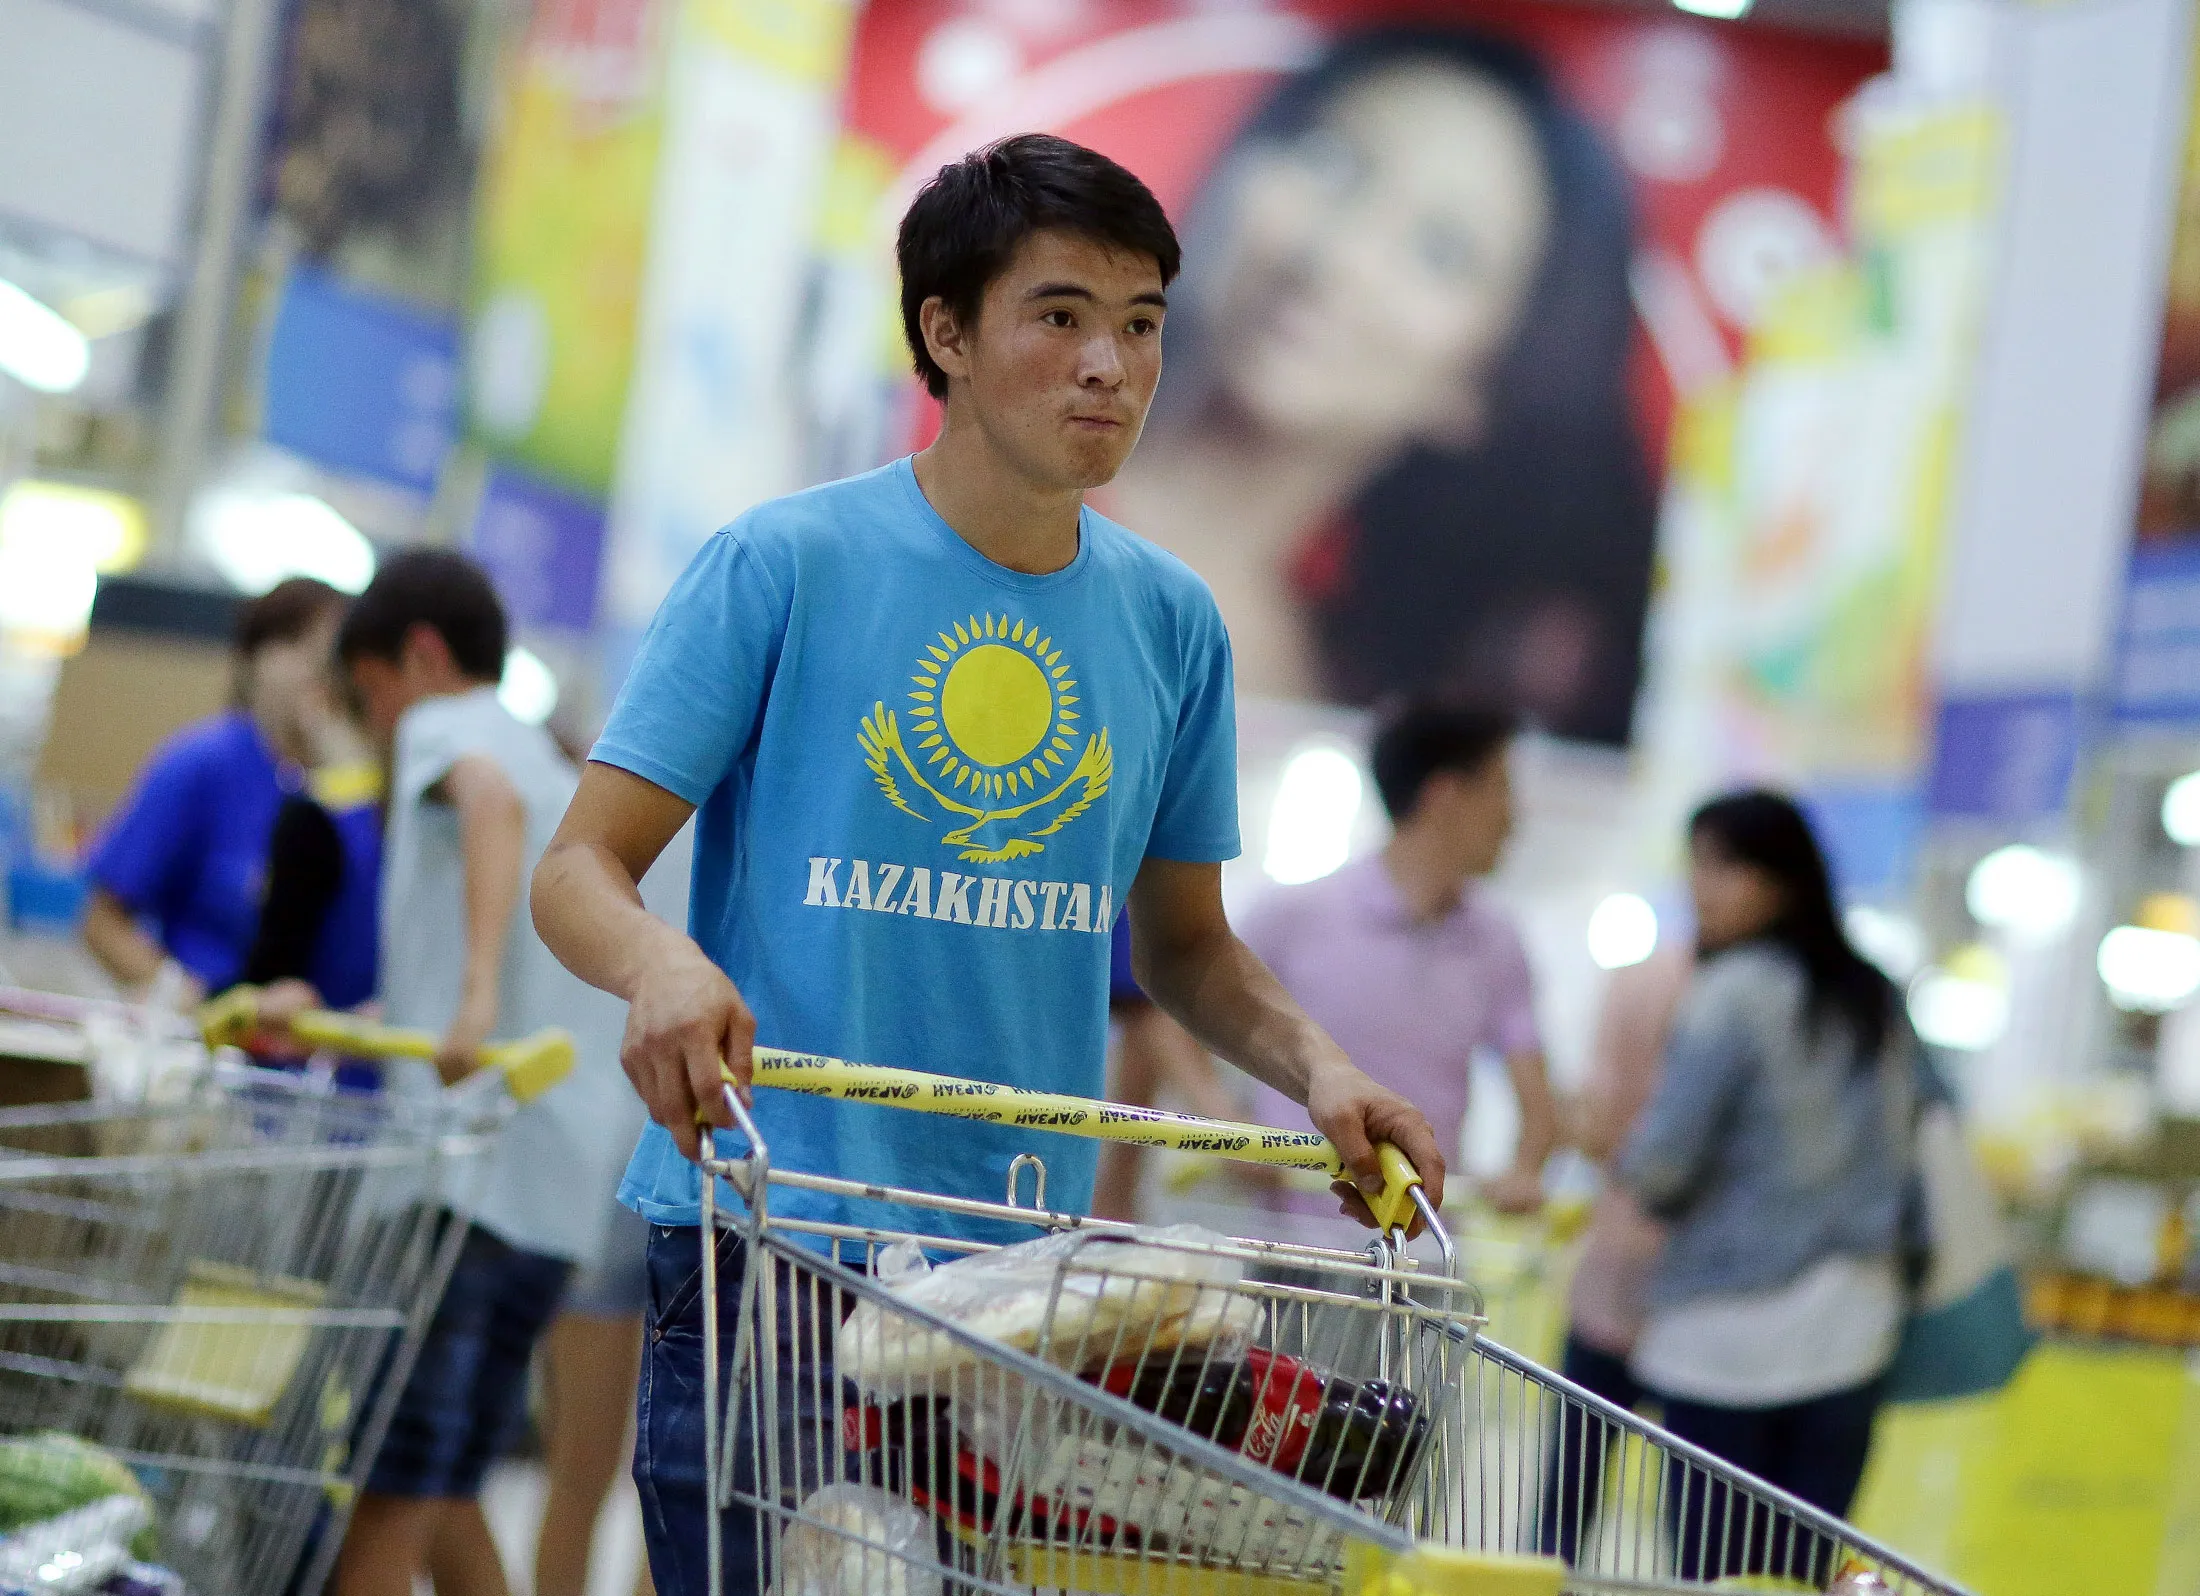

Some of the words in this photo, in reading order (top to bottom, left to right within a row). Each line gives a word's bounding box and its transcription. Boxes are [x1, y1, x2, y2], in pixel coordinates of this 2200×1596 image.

[803, 857, 1112, 933] KAZAKHSTAN
[762, 1056, 812, 1070] АРЗАН
[844, 1084, 899, 1098] АРЗАН
[933, 1083, 982, 1097] АРЗАН
[1015, 1112, 1067, 1125] АРЗАН
[1178, 1135, 1234, 1150] АРЗАН
[1262, 1134, 1309, 1148] АРЗАН
